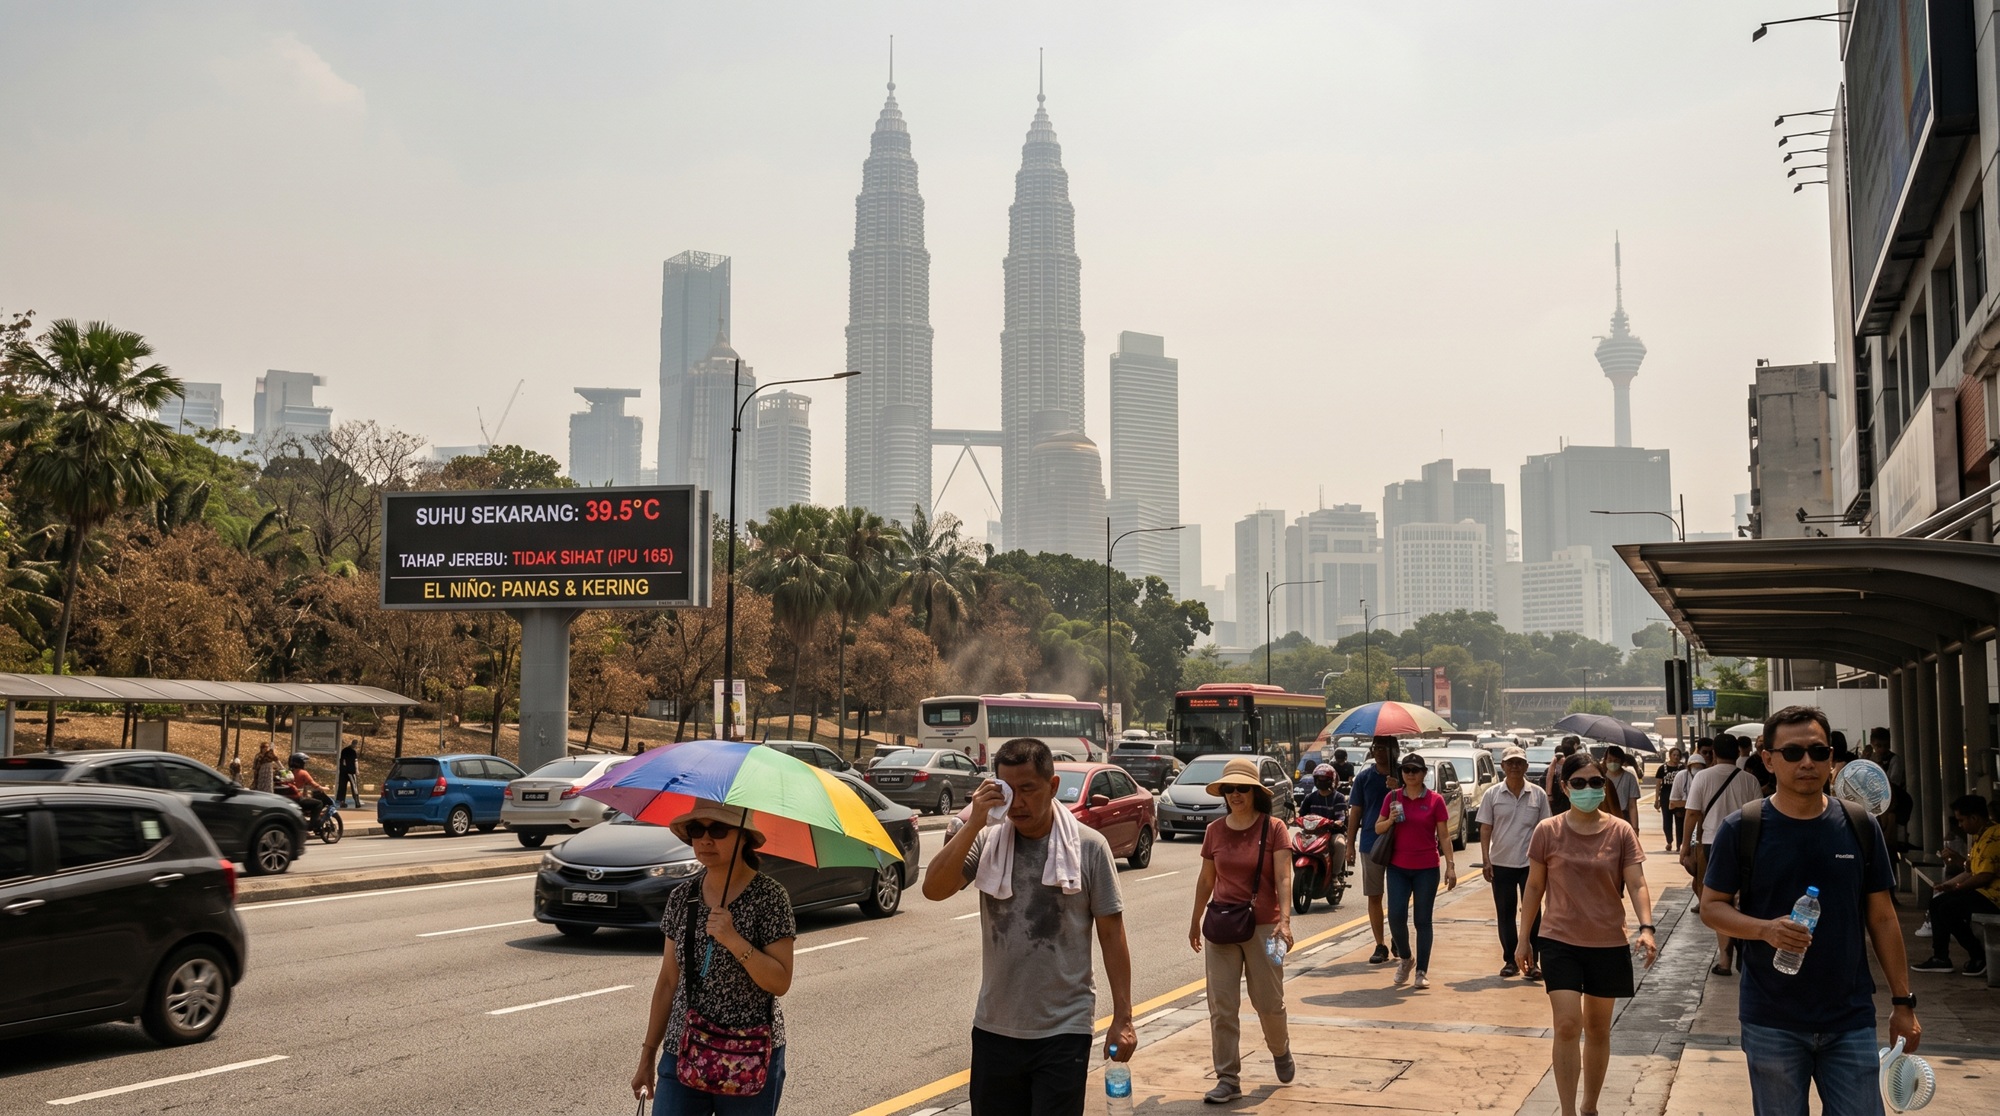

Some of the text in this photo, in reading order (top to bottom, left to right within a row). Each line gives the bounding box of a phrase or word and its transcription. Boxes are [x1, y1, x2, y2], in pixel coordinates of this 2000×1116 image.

[417, 498, 660, 526] SUHU SEKARANG: 39.5°C
[399, 547, 674, 568] TAHAP JEREBU: TIDAK SIHAT (IPU 165)
[425, 578, 649, 599] EL NIÑO: PANAS & KERING
